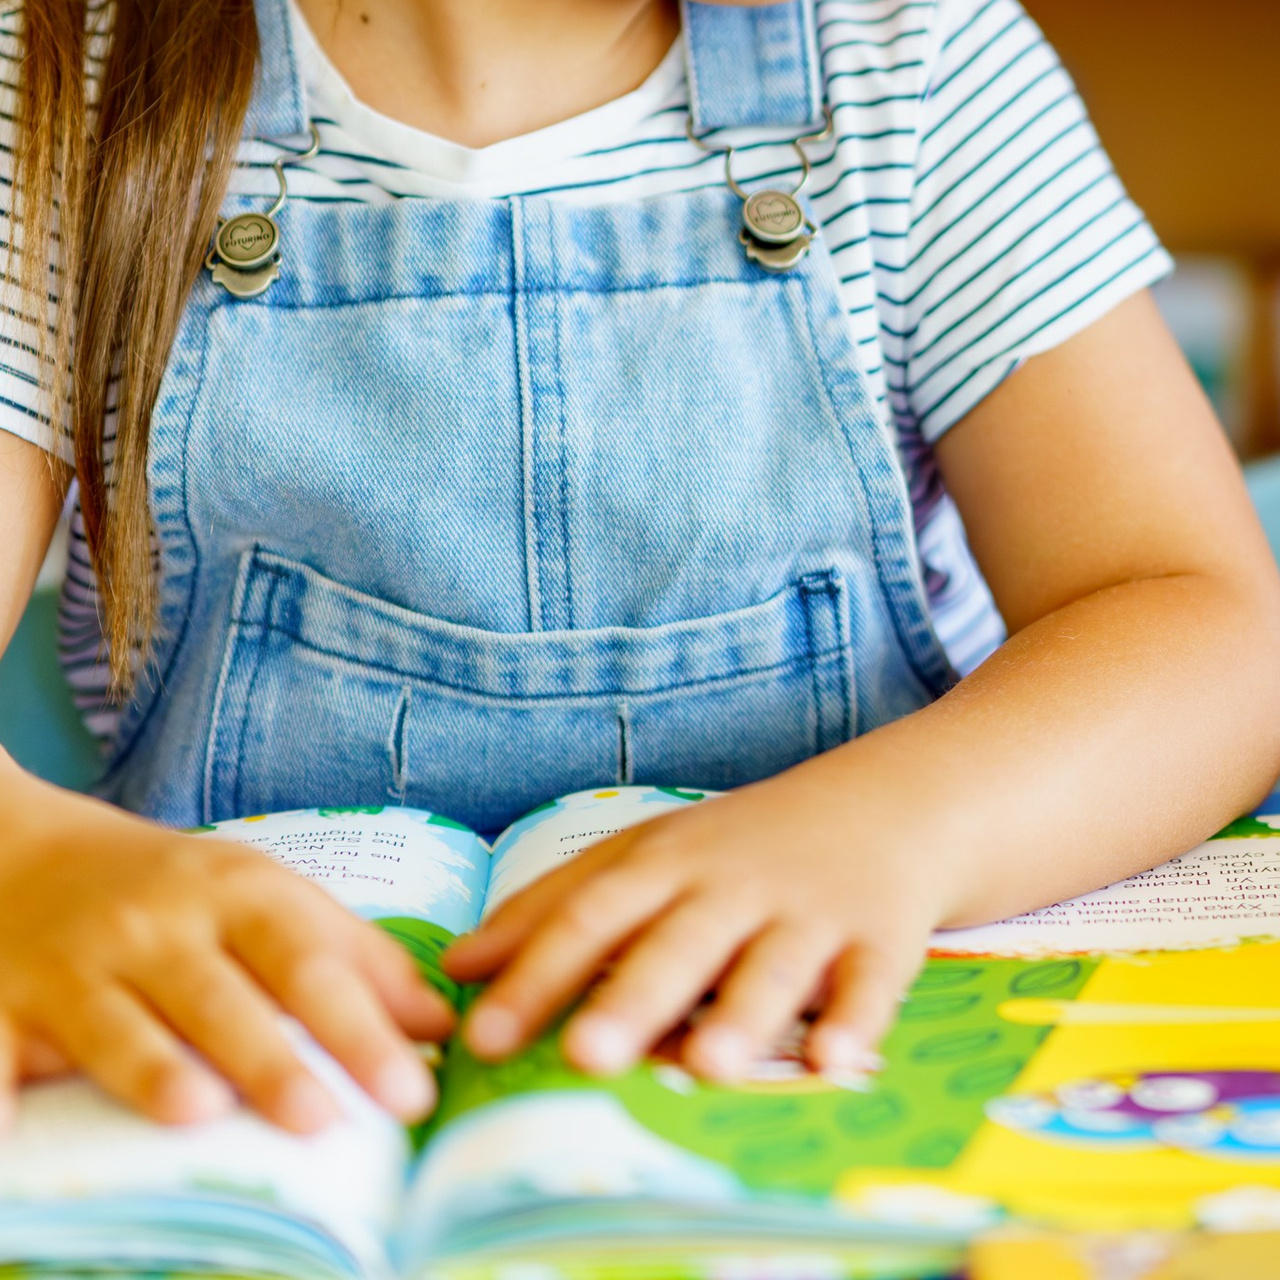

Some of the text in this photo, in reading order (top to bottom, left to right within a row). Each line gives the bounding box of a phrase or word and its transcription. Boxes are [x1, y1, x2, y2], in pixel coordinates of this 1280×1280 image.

[225, 232, 270, 248] FUTURINO
[280, 830, 362, 840] frightful
[372, 839, 404, 848] the
[371, 853, 400, 863] his
[342, 873, 394, 885] fixed
[1124, 880, 1211, 888] Песине
